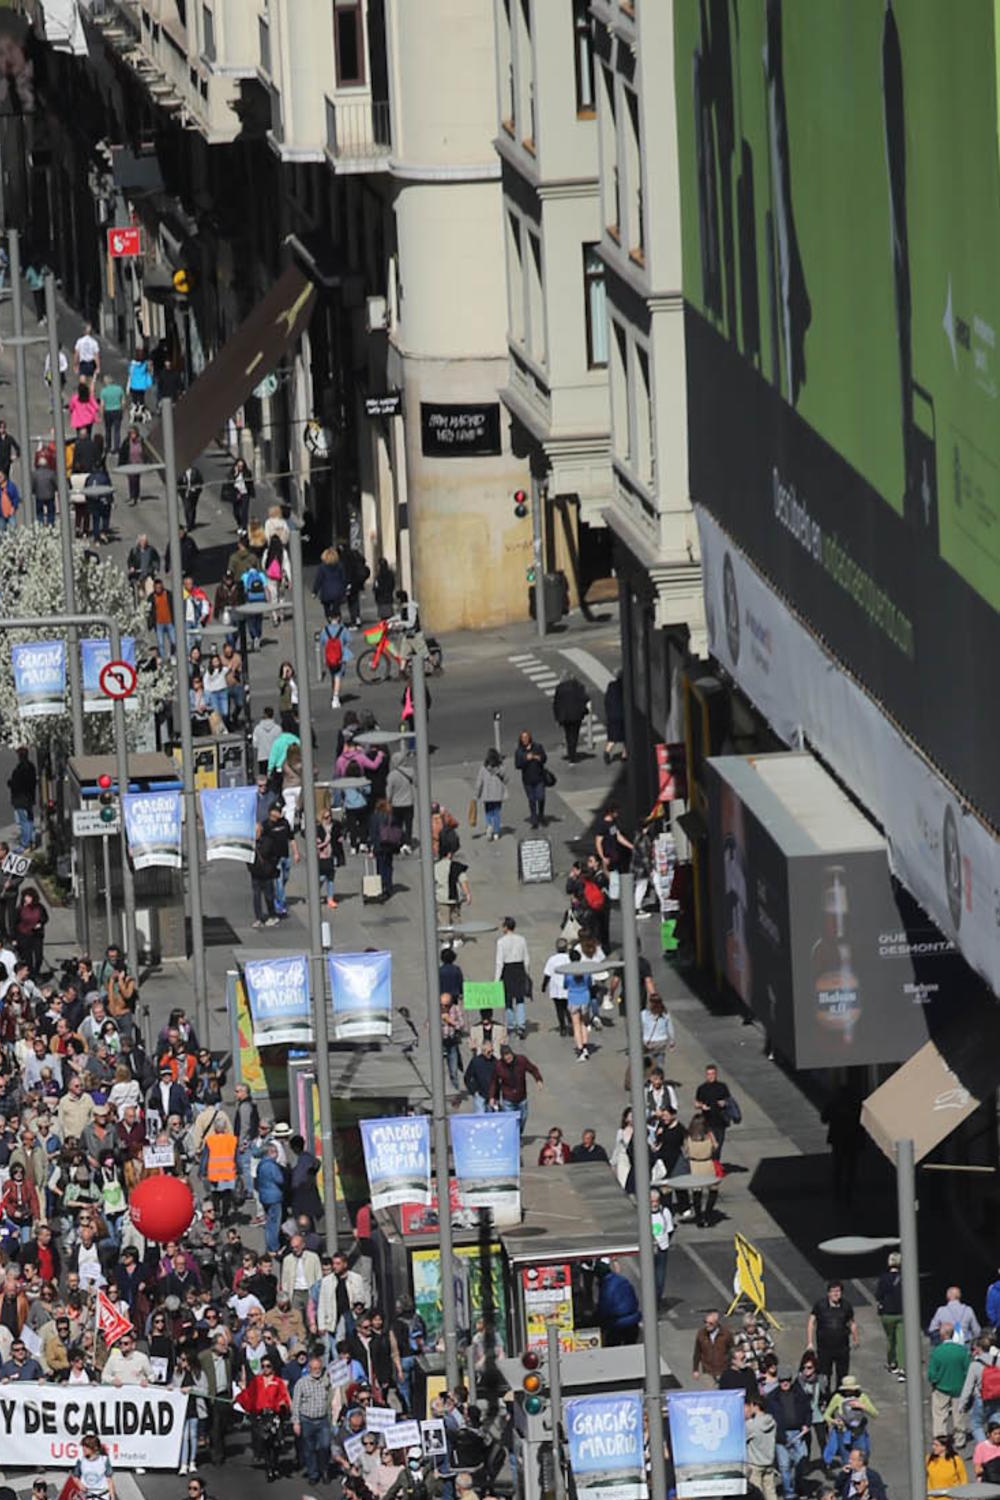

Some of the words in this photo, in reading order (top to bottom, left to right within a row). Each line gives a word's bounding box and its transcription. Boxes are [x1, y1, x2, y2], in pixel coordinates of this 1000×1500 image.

[5, 853, 28, 871] NO
[879, 932, 906, 944] QUE
[0, 1399, 18, 1434] Y
[23, 1400, 58, 1435] DE
[63, 1400, 174, 1436] CALIDAD
[572, 1402, 638, 1435] GRACIAS
[578, 1431, 636, 1460] MADRID
